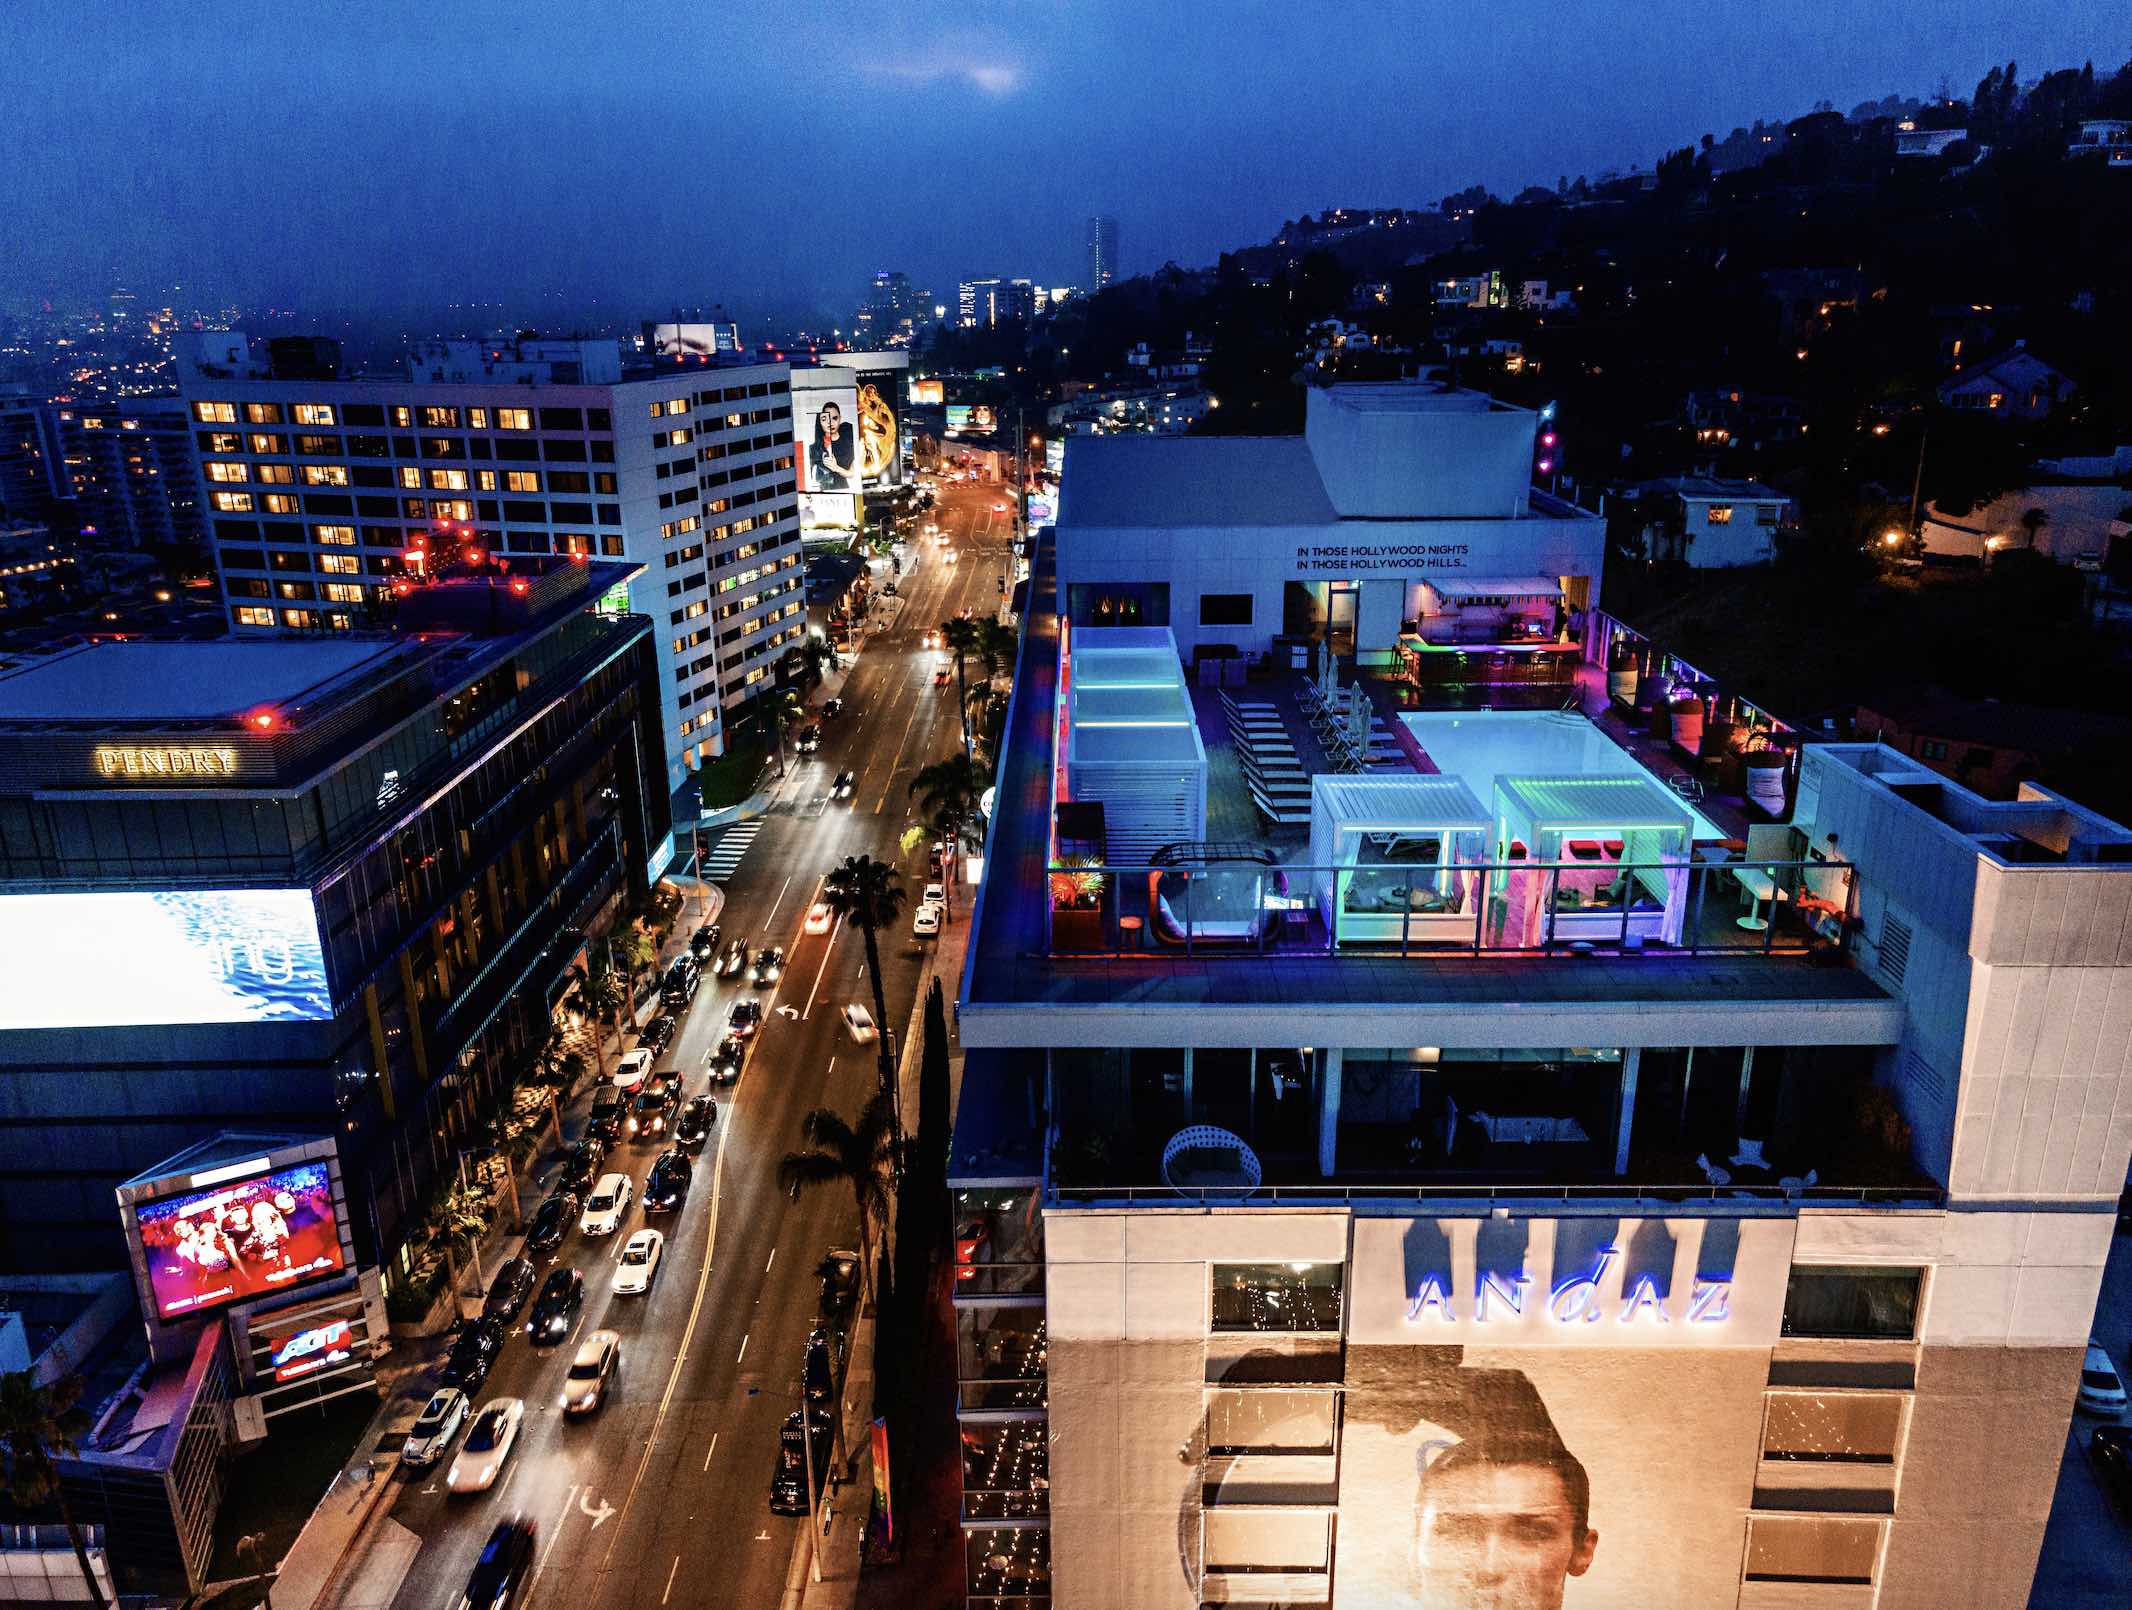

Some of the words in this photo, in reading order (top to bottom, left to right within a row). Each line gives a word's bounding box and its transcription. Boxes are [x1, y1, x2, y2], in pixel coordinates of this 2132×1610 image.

[1297, 547, 1308, 557] IN
[1312, 546, 1348, 557] THOSE
[1351, 545, 1426, 556] HOLLYWOOD
[1428, 545, 1469, 555] NIGHTS
[1297, 560, 1308, 570] IN
[1311, 560, 1348, 570] THOSE
[1350, 558, 1425, 569] HOLLYWOOD
[100, 750, 235, 773] PENDRY
